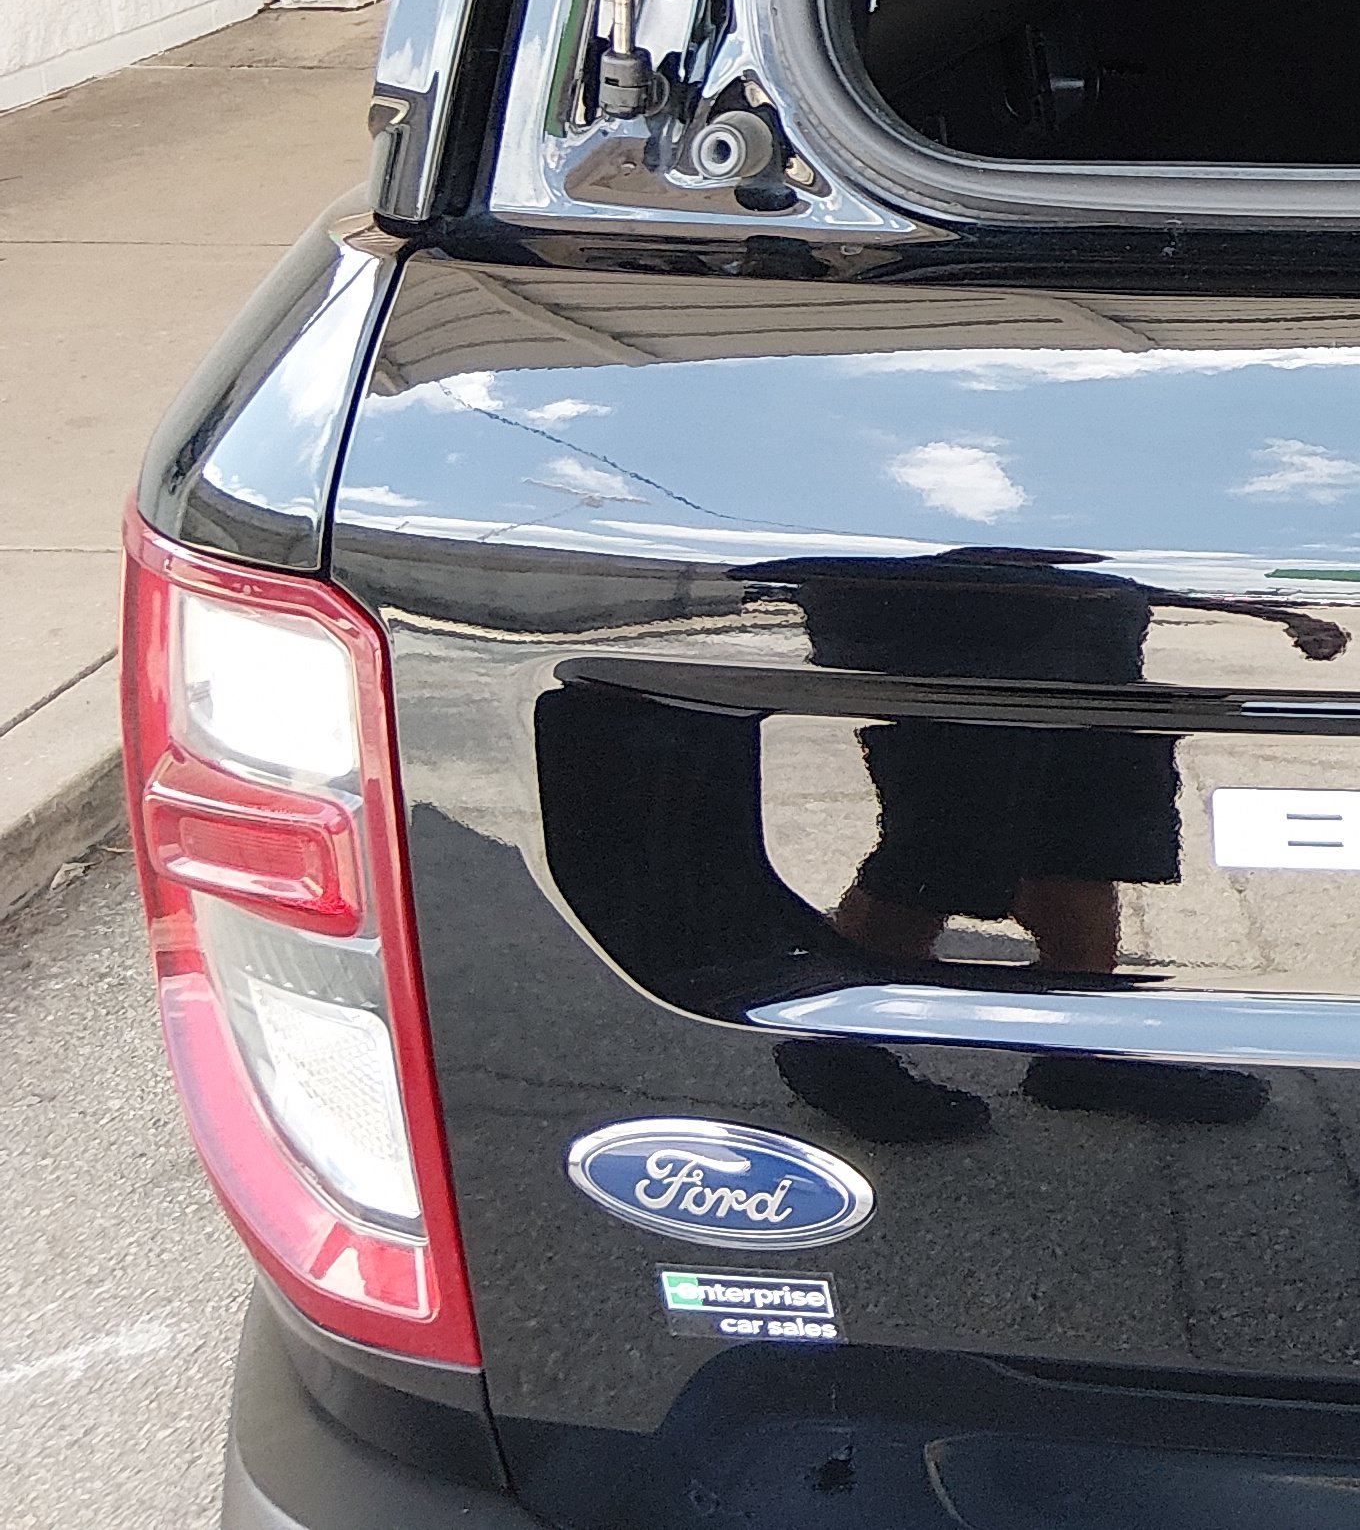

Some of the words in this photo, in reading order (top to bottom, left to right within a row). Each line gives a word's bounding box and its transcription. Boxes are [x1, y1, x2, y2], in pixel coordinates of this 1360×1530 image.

[634, 1148, 793, 1223] Ford
[673, 1282, 826, 1308] enterprise
[718, 1317, 764, 1335] car
[767, 1317, 838, 1339] sales
